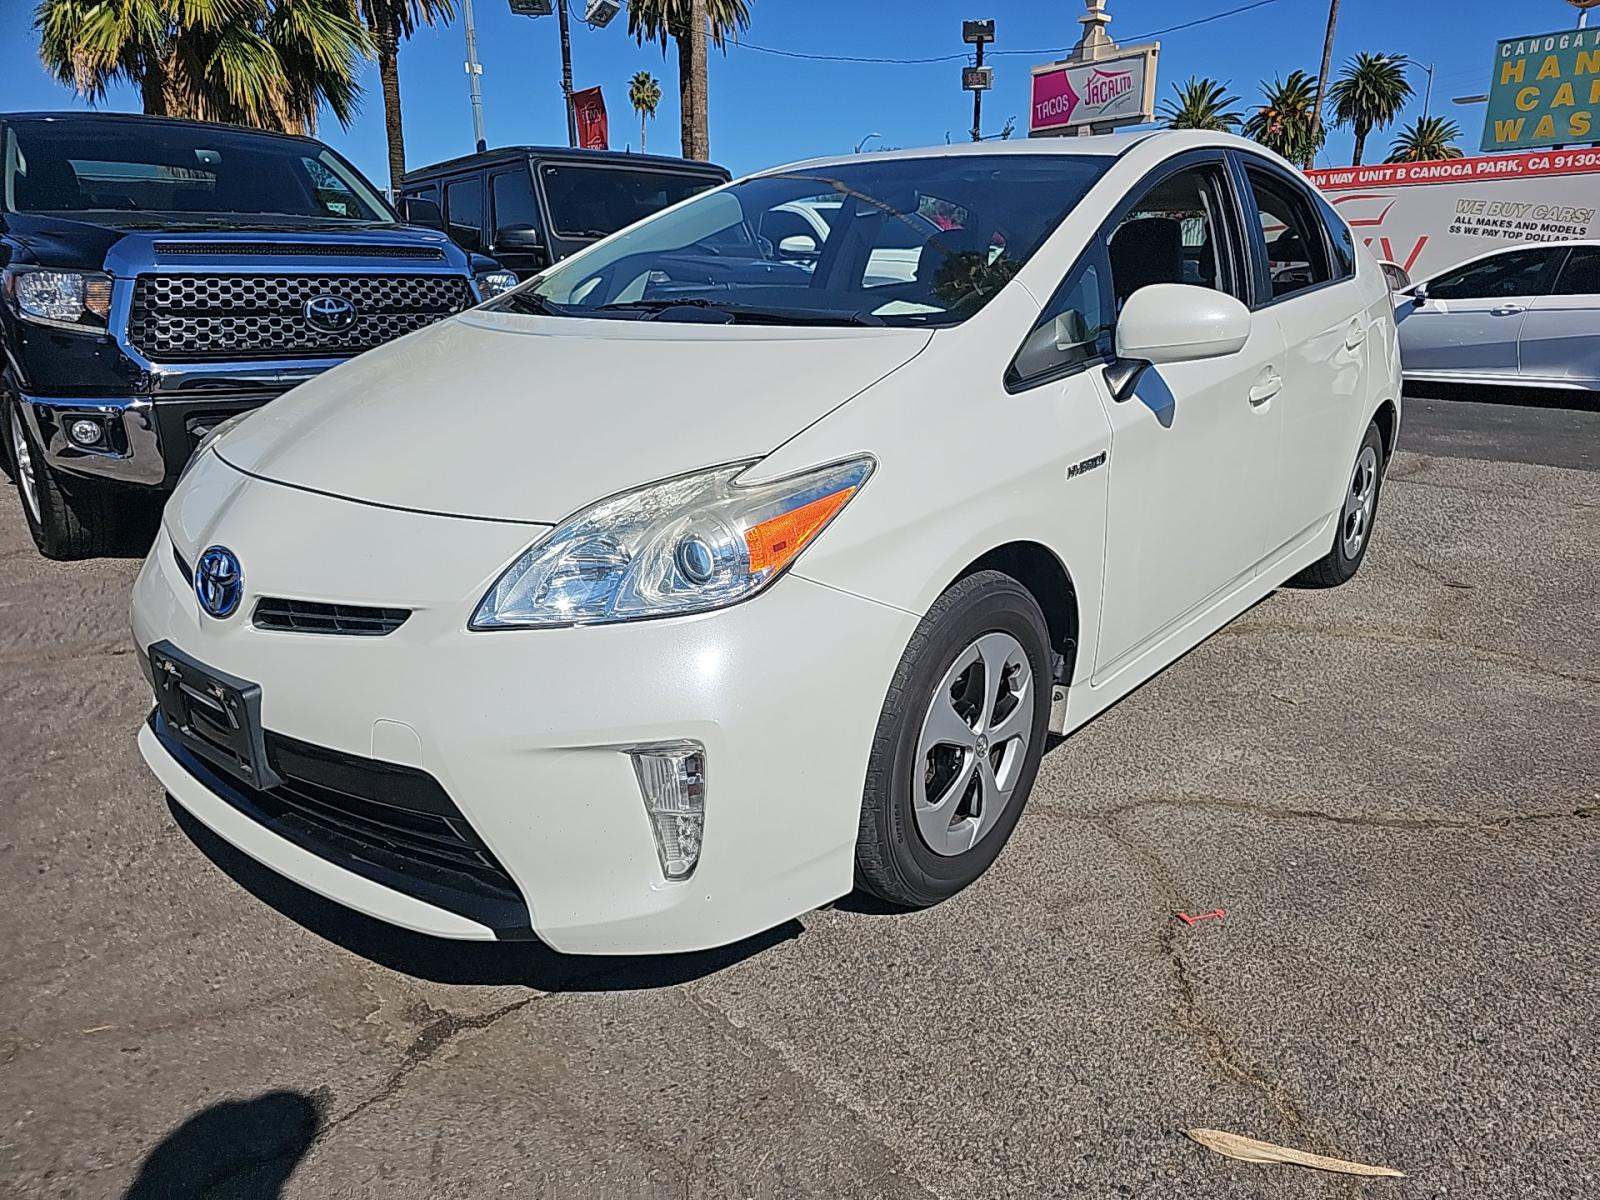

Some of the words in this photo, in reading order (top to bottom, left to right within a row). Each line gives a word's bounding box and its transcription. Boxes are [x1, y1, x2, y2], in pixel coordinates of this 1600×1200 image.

[1502, 33, 1584, 58] CANOGA
[1084, 74, 1132, 105] JACALITO
[1036, 94, 1069, 120] TACOS
[1494, 111, 1592, 143] WAS
[1329, 172, 1357, 185] WAY
[1359, 168, 1394, 182] UNIT
[1395, 167, 1406, 180] B
[1409, 163, 1473, 179] CANOGA
[1476, 159, 1523, 174] PARK,
[1527, 157, 1550, 170] CA
[1456, 198, 1487, 215] WE
[1487, 201, 1533, 219] BUY
[1532, 204, 1596, 225] CARS!
[1454, 215, 1474, 225] ALL
[1475, 217, 1513, 229] MAKES
[1514, 221, 1538, 231] AND
[1539, 223, 1588, 236] MODELS
[1463, 226, 1480, 236] WE
[1481, 228, 1500, 238] PAY
[1502, 230, 1523, 240] TOP
